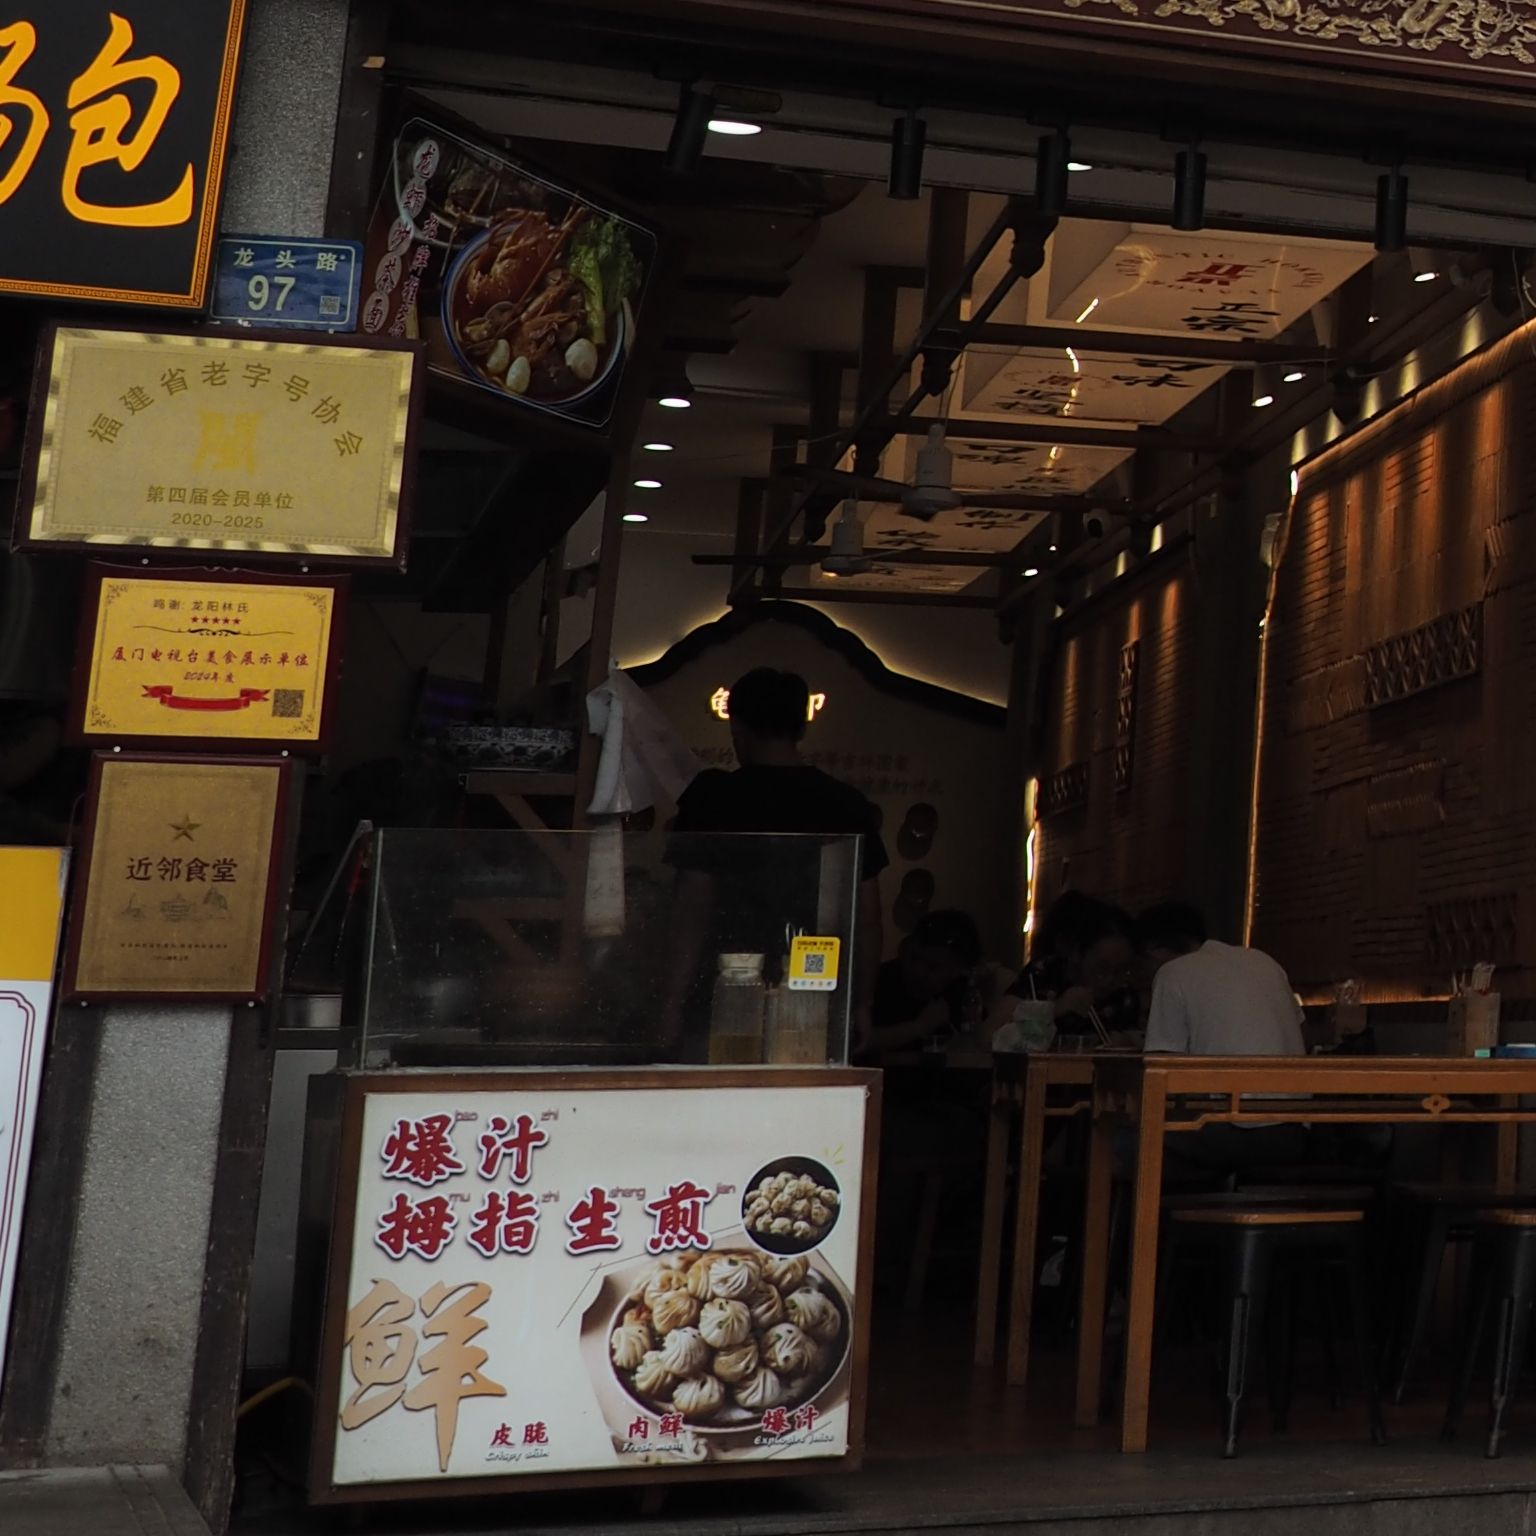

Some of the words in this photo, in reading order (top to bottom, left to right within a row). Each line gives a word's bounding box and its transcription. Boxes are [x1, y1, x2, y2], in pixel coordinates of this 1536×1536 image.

[232, 245, 340, 273] 龙头路
[248, 275, 296, 312] 97
[88, 360, 364, 457] 福建省老字号协会
[146, 485, 295, 510] 第四届会员单位
[171, 512, 264, 530] 2020-2025
[127, 857, 239, 883] 近邻食堂
[384, 1113, 548, 1182] 爆汁
[377, 1181, 713, 1256] 拇指生煎
[341, 1279, 507, 1473] 鲜
[490, 1422, 549, 1447] 皮脆
[627, 1413, 685, 1439] 肉鲜
[762, 1406, 819, 1435] 爆汁
